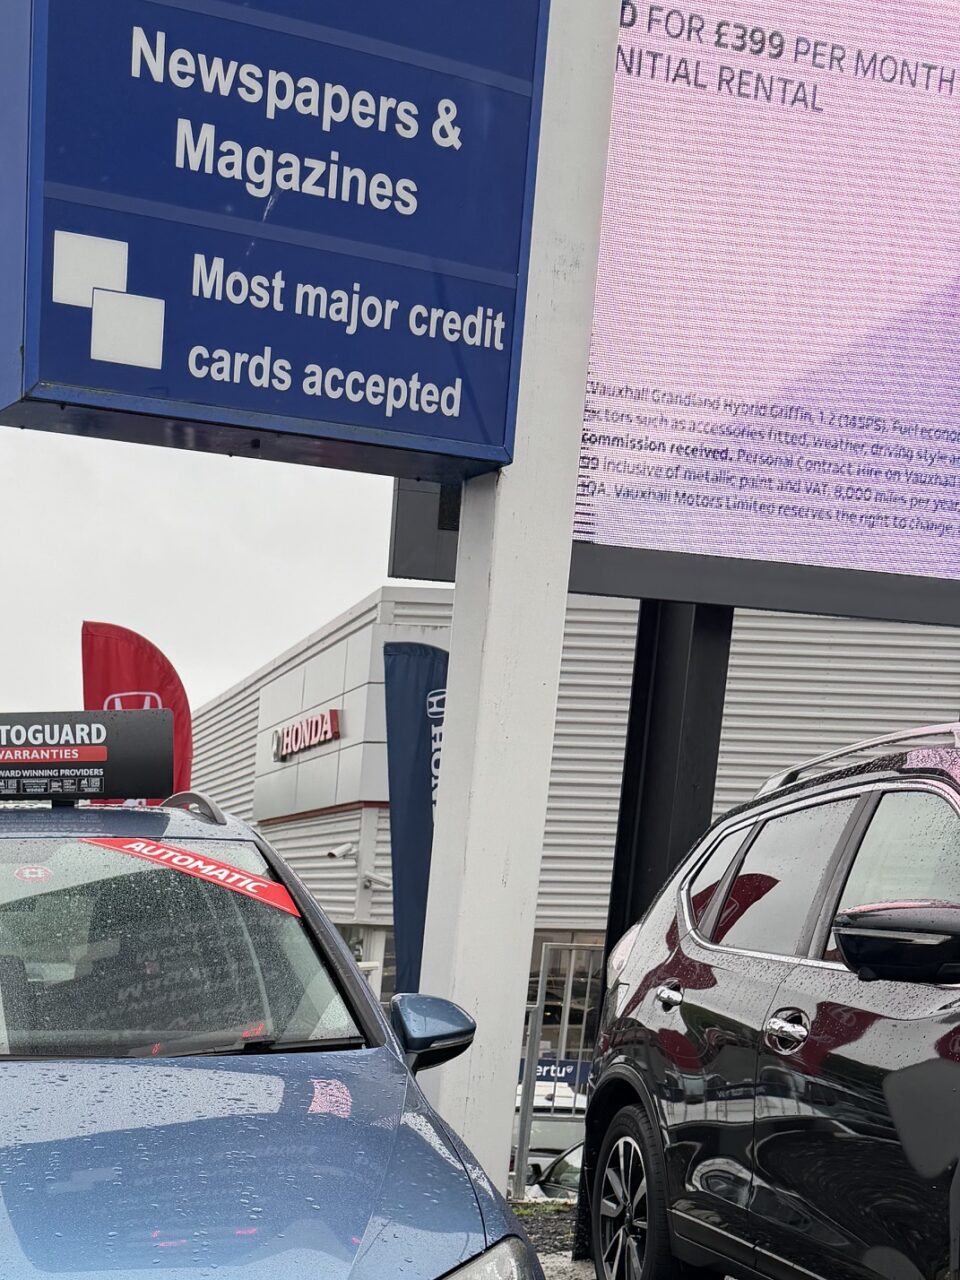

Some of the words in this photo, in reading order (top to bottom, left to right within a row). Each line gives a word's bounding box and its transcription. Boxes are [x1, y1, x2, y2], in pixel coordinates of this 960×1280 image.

[647, 5, 705, 43] FOR
[714, 20, 785, 60] £399
[794, 36, 847, 73] PER
[854, 48, 956, 96] MONTH
[131, 26, 419, 140] Newspapers
[431, 97, 463, 150] &
[717, 65, 824, 112] RENTAL
[174, 118, 419, 216] Magazines
[191, 253, 286, 312] Most
[294, 281, 399, 335] major
[408, 302, 506, 351] credit
[187, 345, 292, 393] cards
[302, 361, 462, 418] accepted
[281, 709, 337, 756] HONDA
[21, 769, 59, 778] WINNING
[59, 768, 104, 777] PROVIDERS
[123, 841, 268, 894] AUTOMATIC
[536, 1064, 566, 1077] ertu
